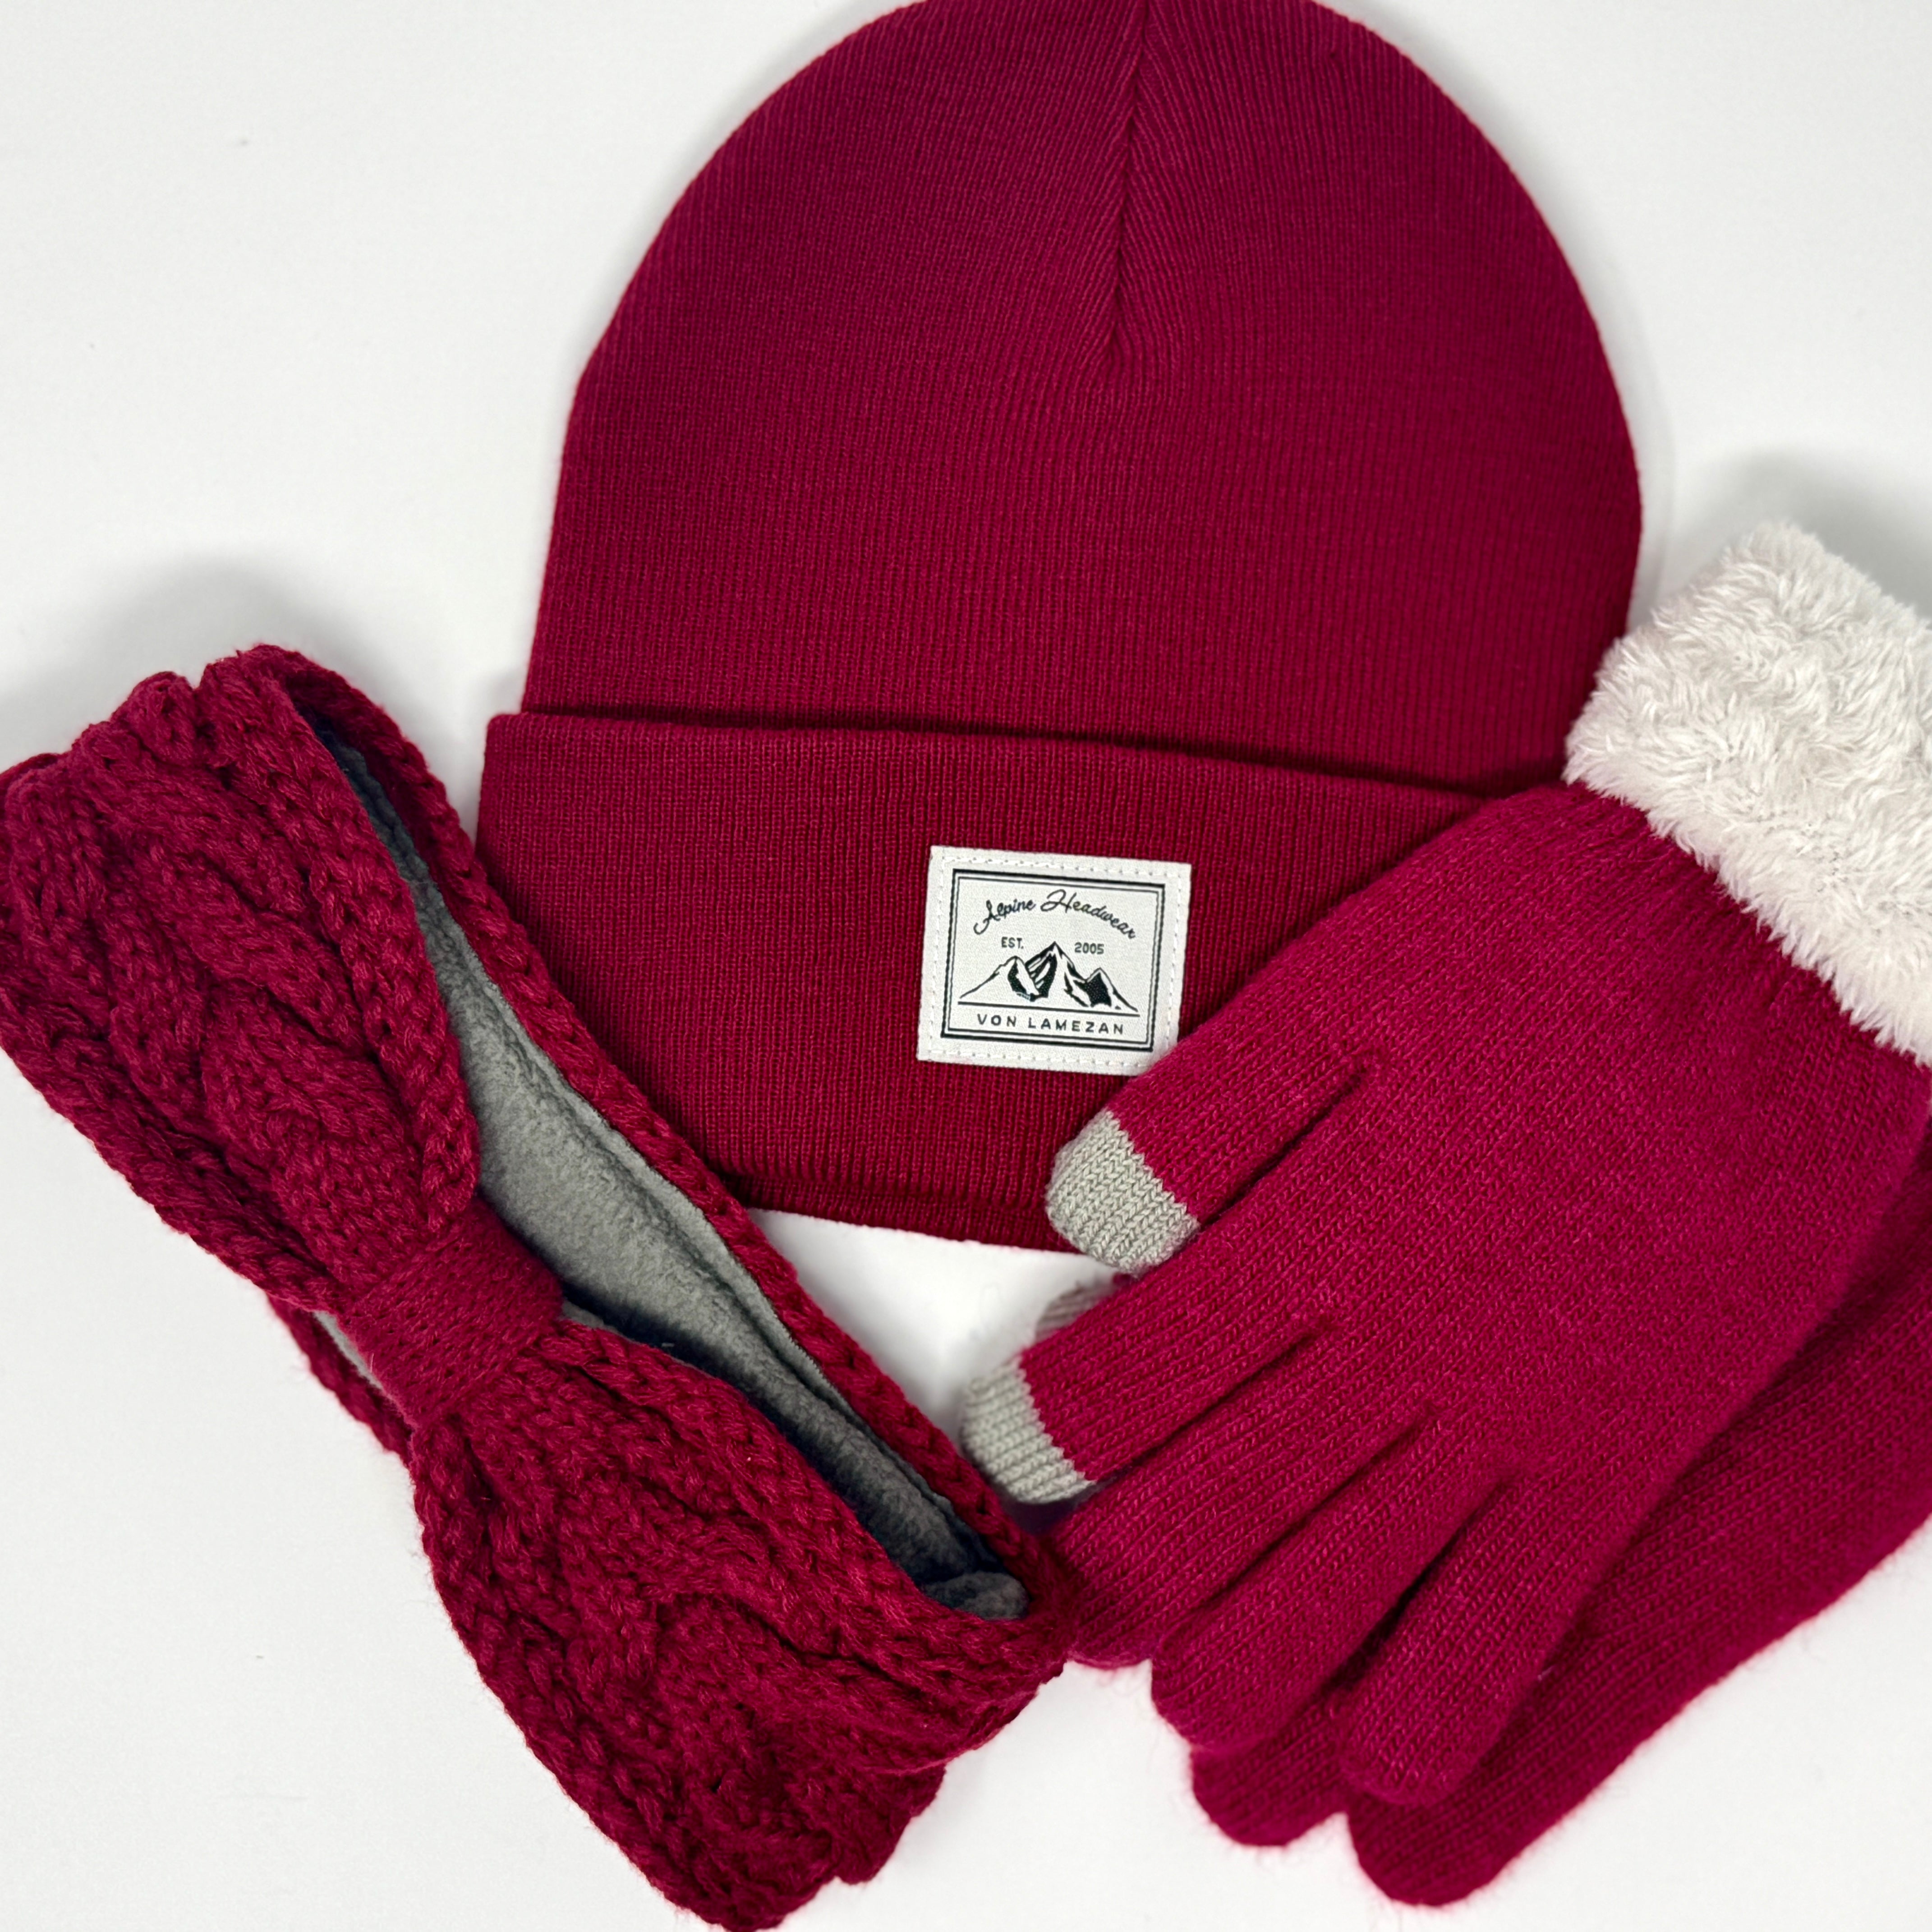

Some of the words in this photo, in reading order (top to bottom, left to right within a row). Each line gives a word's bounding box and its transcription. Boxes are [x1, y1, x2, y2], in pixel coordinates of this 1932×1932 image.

[973, 899, 1036, 935] Alpine
[1040, 888, 1136, 939] Headwear
[1001, 936, 1024, 949] EST.
[1074, 942, 1104, 955] 2005
[977, 1013, 1017, 1027] VON
[1027, 1017, 1123, 1035] LAMEZAN
